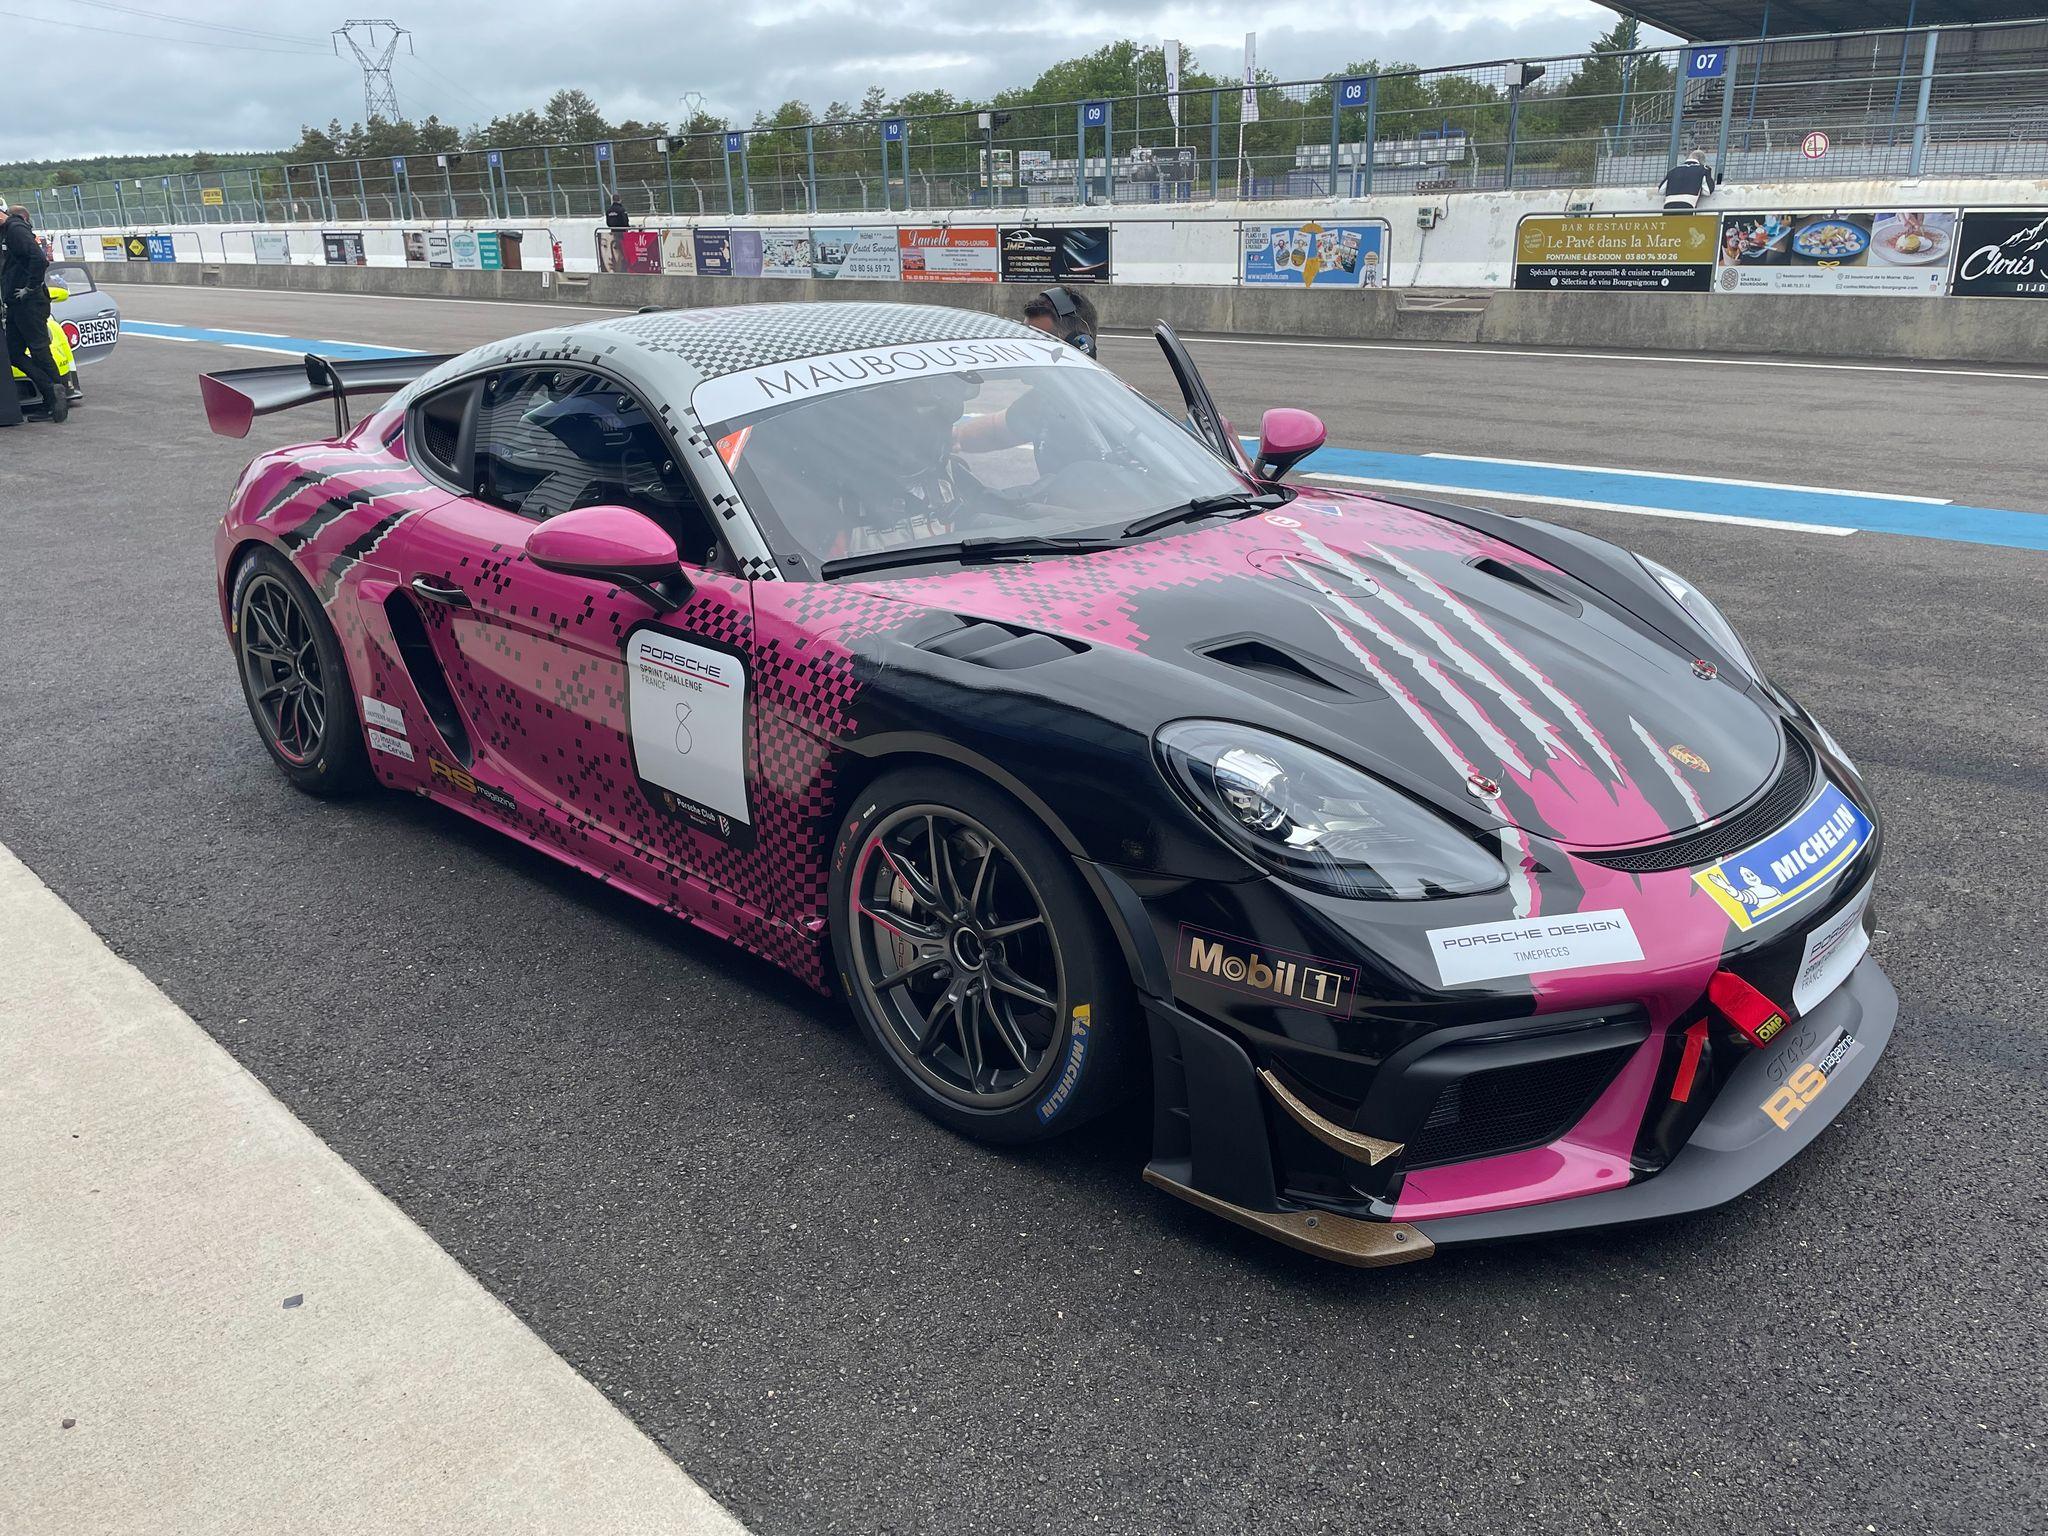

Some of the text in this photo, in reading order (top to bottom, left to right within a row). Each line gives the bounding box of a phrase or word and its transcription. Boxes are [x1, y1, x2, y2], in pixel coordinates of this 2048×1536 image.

[1697, 54, 1717, 69] 07
[1346, 85, 1361, 98] 08
[1088, 108, 1100, 120] 09
[889, 124, 898, 135] 10
[730, 137, 737, 146] 11
[599, 146, 606, 155] 12
[1561, 222, 1666, 231] BAR RESTAURANT
[1003, 242, 1026, 250] JMP
[1547, 235, 1563, 249] Le
[1566, 234, 1595, 249] Pavé
[1597, 235, 1627, 248] dans
[1631, 235, 1642, 247] la
[1646, 234, 1681, 247] Mare
[1546, 252, 1622, 261] FONTAINE-LÈS-DIJON
[1960, 245, 2034, 280] Chris
[849, 264, 857, 272] 03
[858, 264, 865, 272] 80
[883, 264, 891, 272] 72
[1529, 268, 1558, 277] Spécialité
[1580, 268, 1588, 276] de
[1589, 269, 1620, 277] grenouille
[1651, 268, 1696, 276] traditionnelle
[1560, 278, 1658, 287] Sélection de vins Bourguignons
[79, 319, 116, 334] BENSON
[80, 330, 116, 345] CHERRY
[755, 344, 1035, 398] MAUBOUSSIN
[640, 644, 721, 678] PORSCHE
[640, 663, 703, 692] SPRINT CHALLENGE
[641, 674, 667, 690] FRANCE
[675, 701, 692, 754] 8
[428, 755, 516, 810] RS magazine
[676, 797, 716, 822] Porsche Club
[1770, 803, 1856, 884] MICHELIN
[1442, 920, 1622, 949] PORSCHE DESIGN
[1514, 946, 1570, 962] TIMEPIECES
[1189, 937, 1296, 996] Mobil
[1759, 1016, 1783, 1040] OMP
[1041, 1039, 1084, 1118] MICHELIN
[1760, 1034, 1855, 1131] RS magazine
